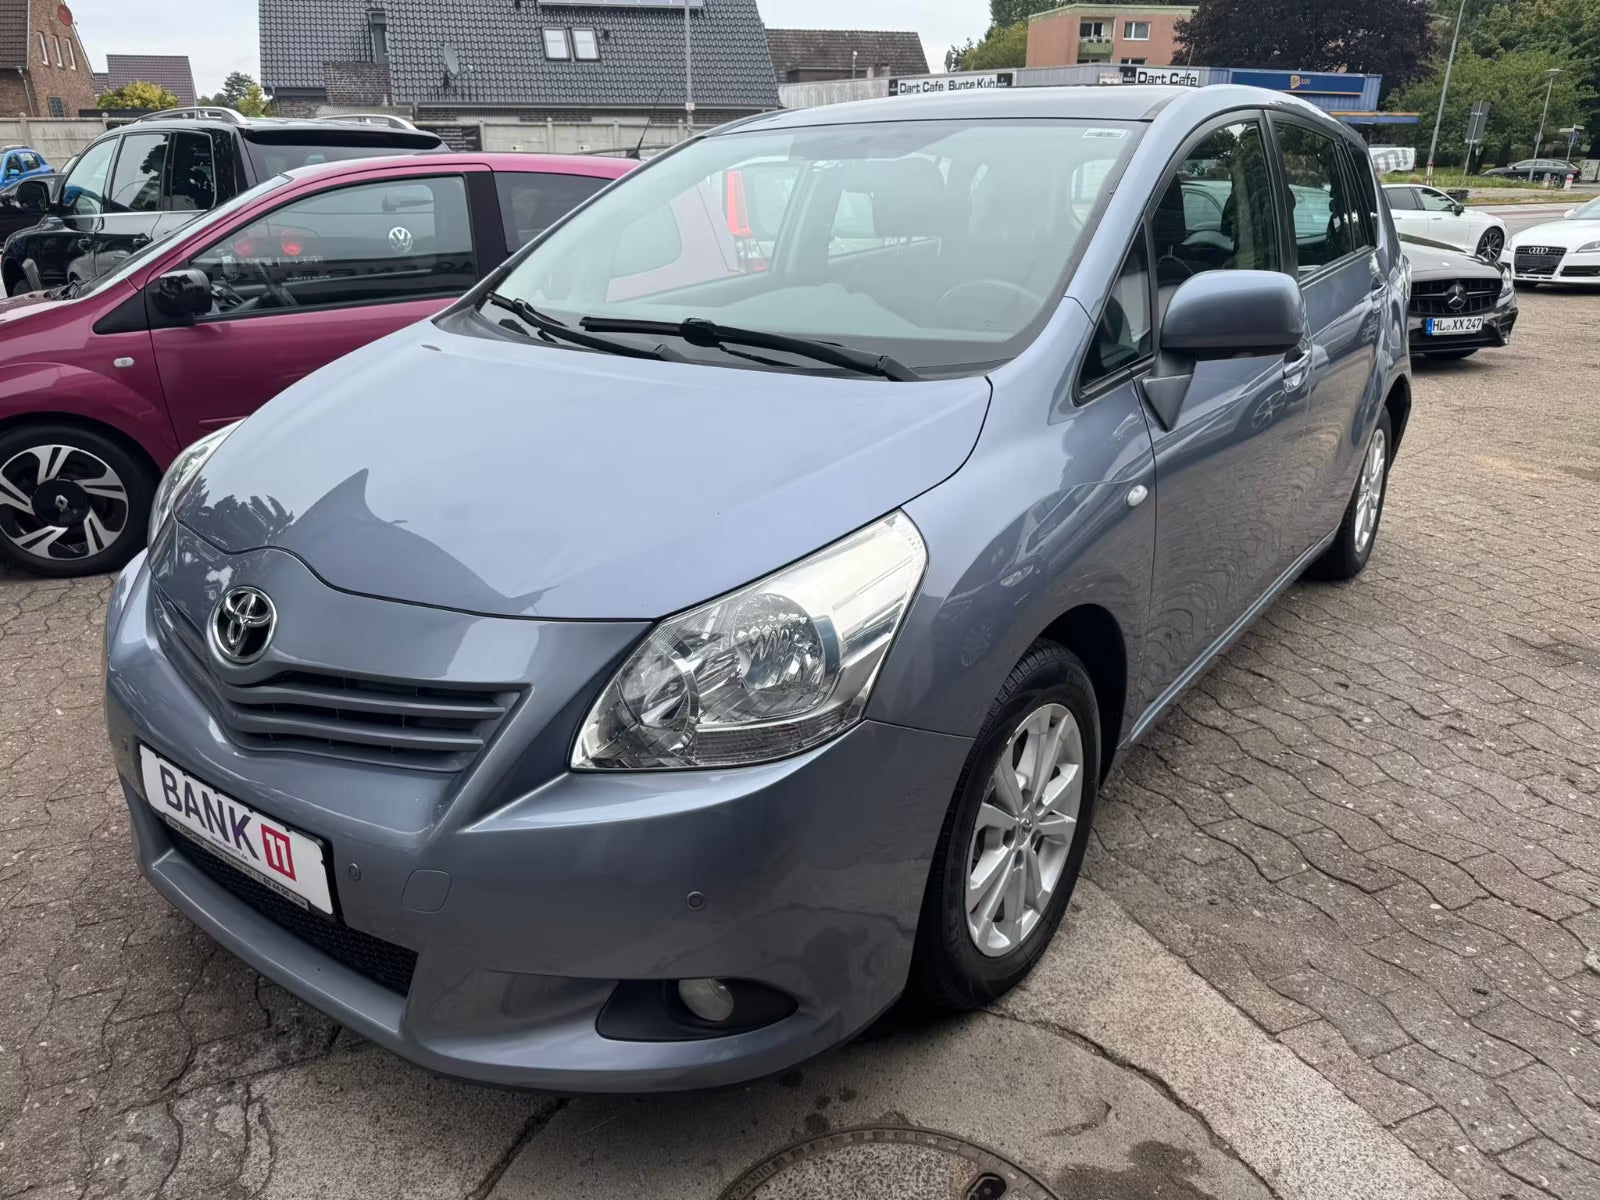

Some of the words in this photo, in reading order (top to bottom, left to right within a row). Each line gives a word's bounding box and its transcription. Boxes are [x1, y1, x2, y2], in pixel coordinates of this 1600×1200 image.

[900, 82, 921, 94] Dart
[922, 80, 944, 92] Cafe
[948, 79, 976, 91] Bunte
[976, 77, 997, 89] Kuh
[1137, 71, 1167, 84] Dart
[1169, 71, 1197, 86] Cafe
[1433, 319, 1446, 331] HL
[1452, 319, 1464, 330] XX
[1465, 317, 1482, 330] 247
[159, 764, 260, 861] BANK
[264, 829, 292, 876] 11
